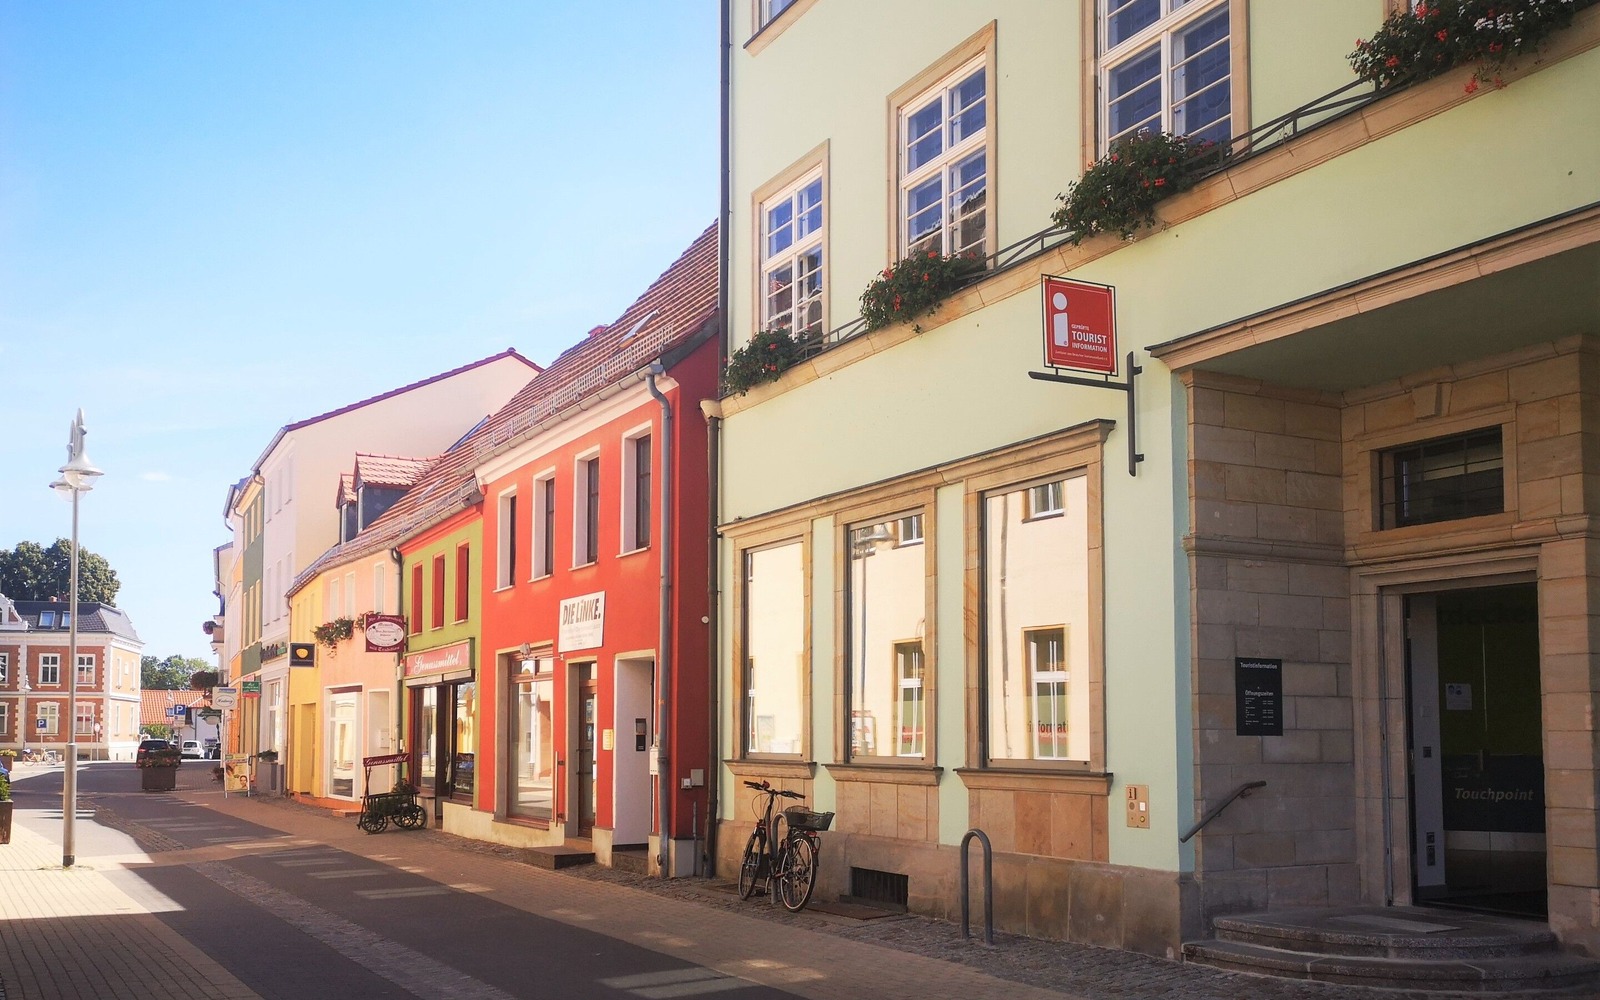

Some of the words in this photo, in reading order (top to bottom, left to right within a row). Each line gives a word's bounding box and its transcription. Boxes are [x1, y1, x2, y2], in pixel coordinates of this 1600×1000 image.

[1071, 330, 1107, 344] TOURIST
[1071, 342, 1108, 352] INFORMATION
[562, 603, 576, 626] DIE
[1240, 662, 1278, 670] Touristinformation
[176, 705, 184, 714] P
[38, 719, 45, 728] P
[1454, 787, 1535, 804] Touchpoint
